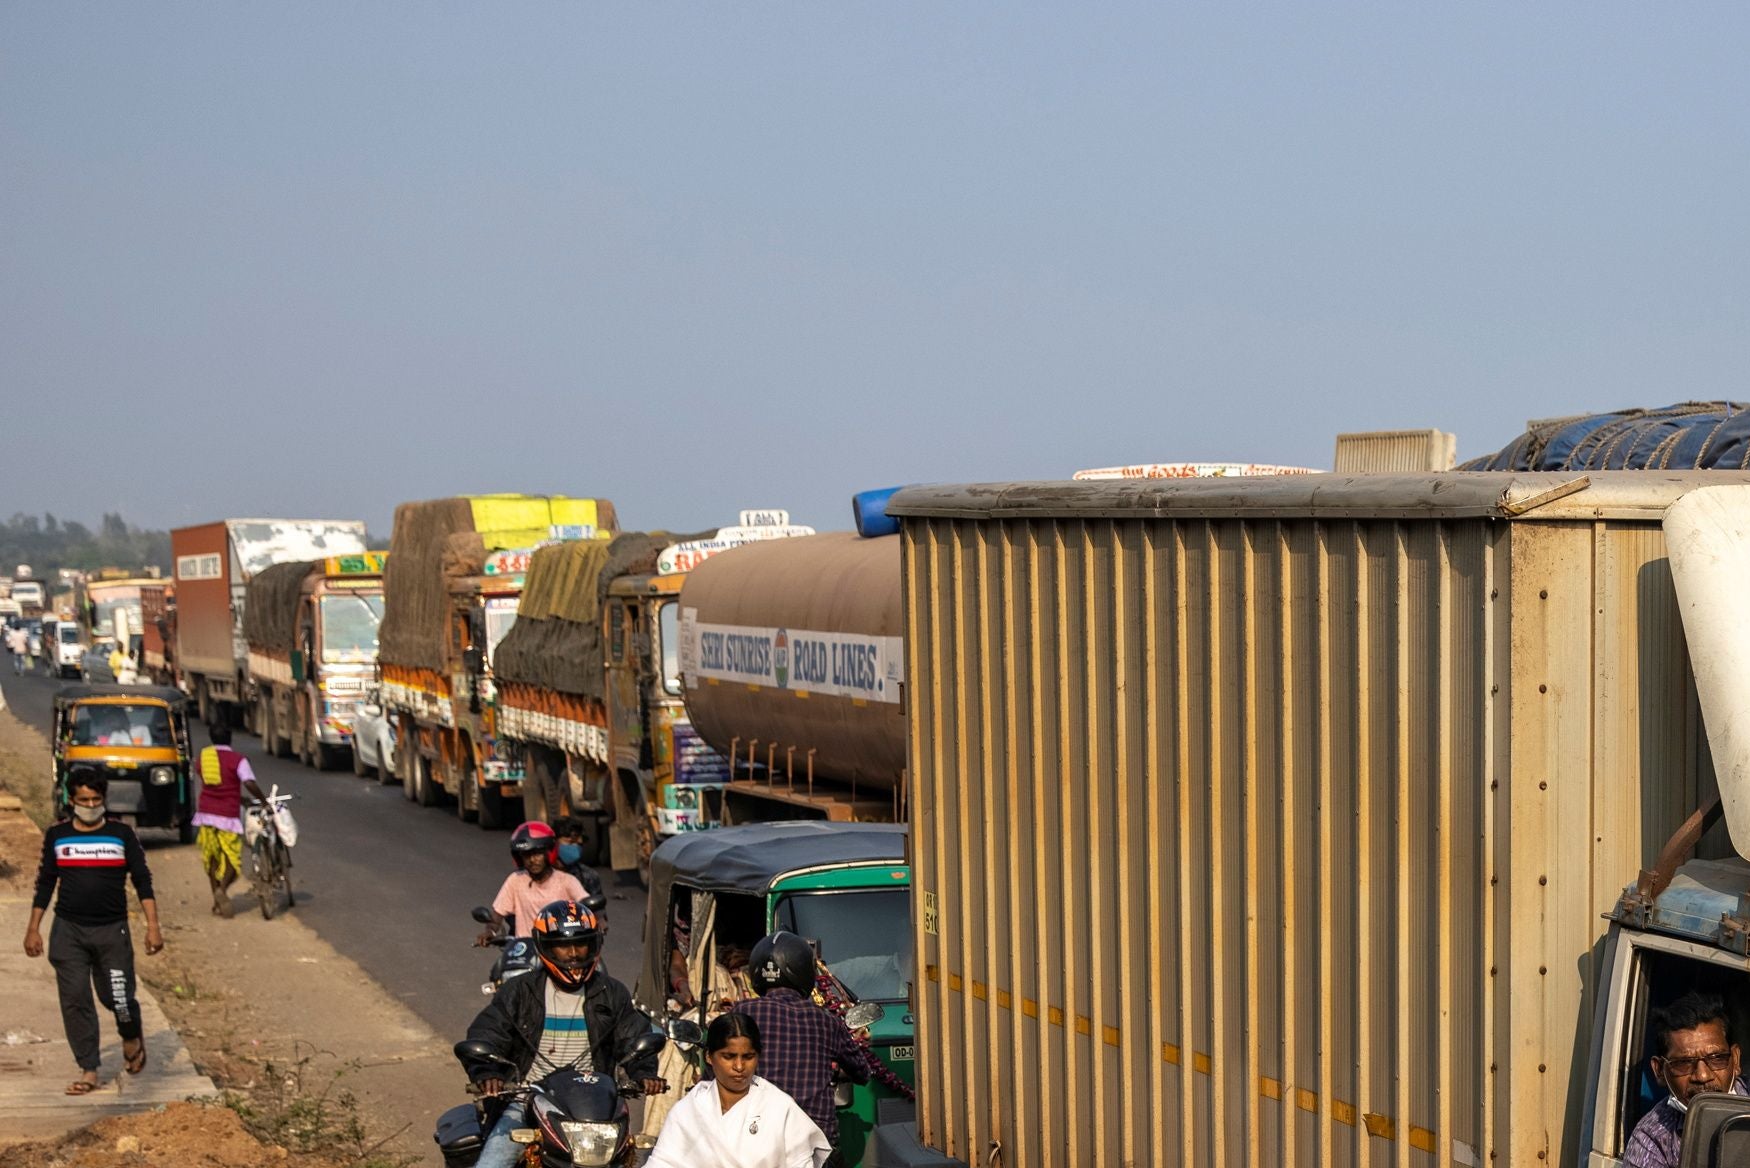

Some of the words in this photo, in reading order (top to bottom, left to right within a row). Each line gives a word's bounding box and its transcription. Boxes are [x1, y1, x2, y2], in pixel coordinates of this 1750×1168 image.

[700, 540, 727, 550] INDIA
[675, 551, 718, 571] RA
[701, 631, 725, 670] SHRI
[726, 633, 771, 677] SUNRISE
[793, 639, 828, 684] ROAD
